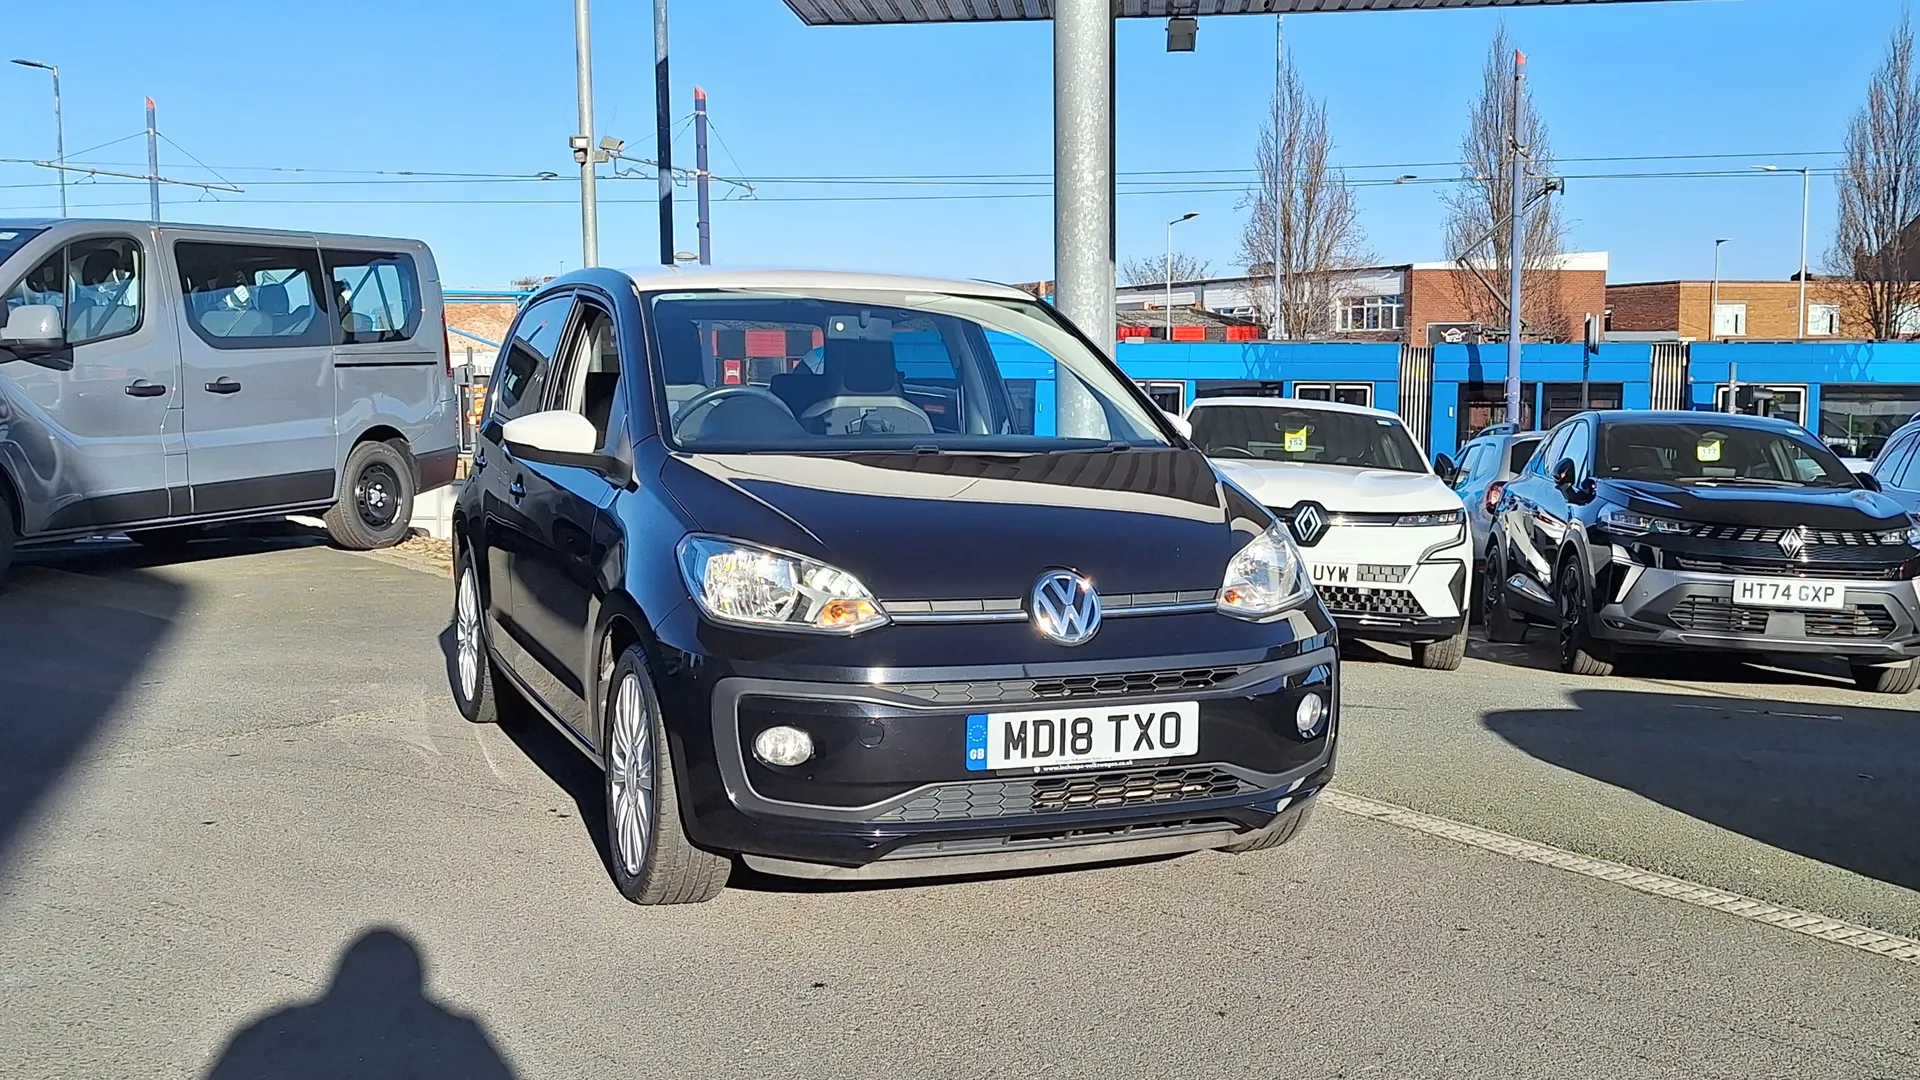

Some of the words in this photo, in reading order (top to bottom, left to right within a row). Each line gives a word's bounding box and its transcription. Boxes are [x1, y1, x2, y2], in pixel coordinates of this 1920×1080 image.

[1313, 564, 1349, 582] UYW
[1742, 582, 1792, 601] HT74
[1798, 585, 1835, 603] GXP
[1003, 716, 1093, 761] MD18
[1107, 711, 1182, 753] TXO
[969, 748, 985, 760] GB
